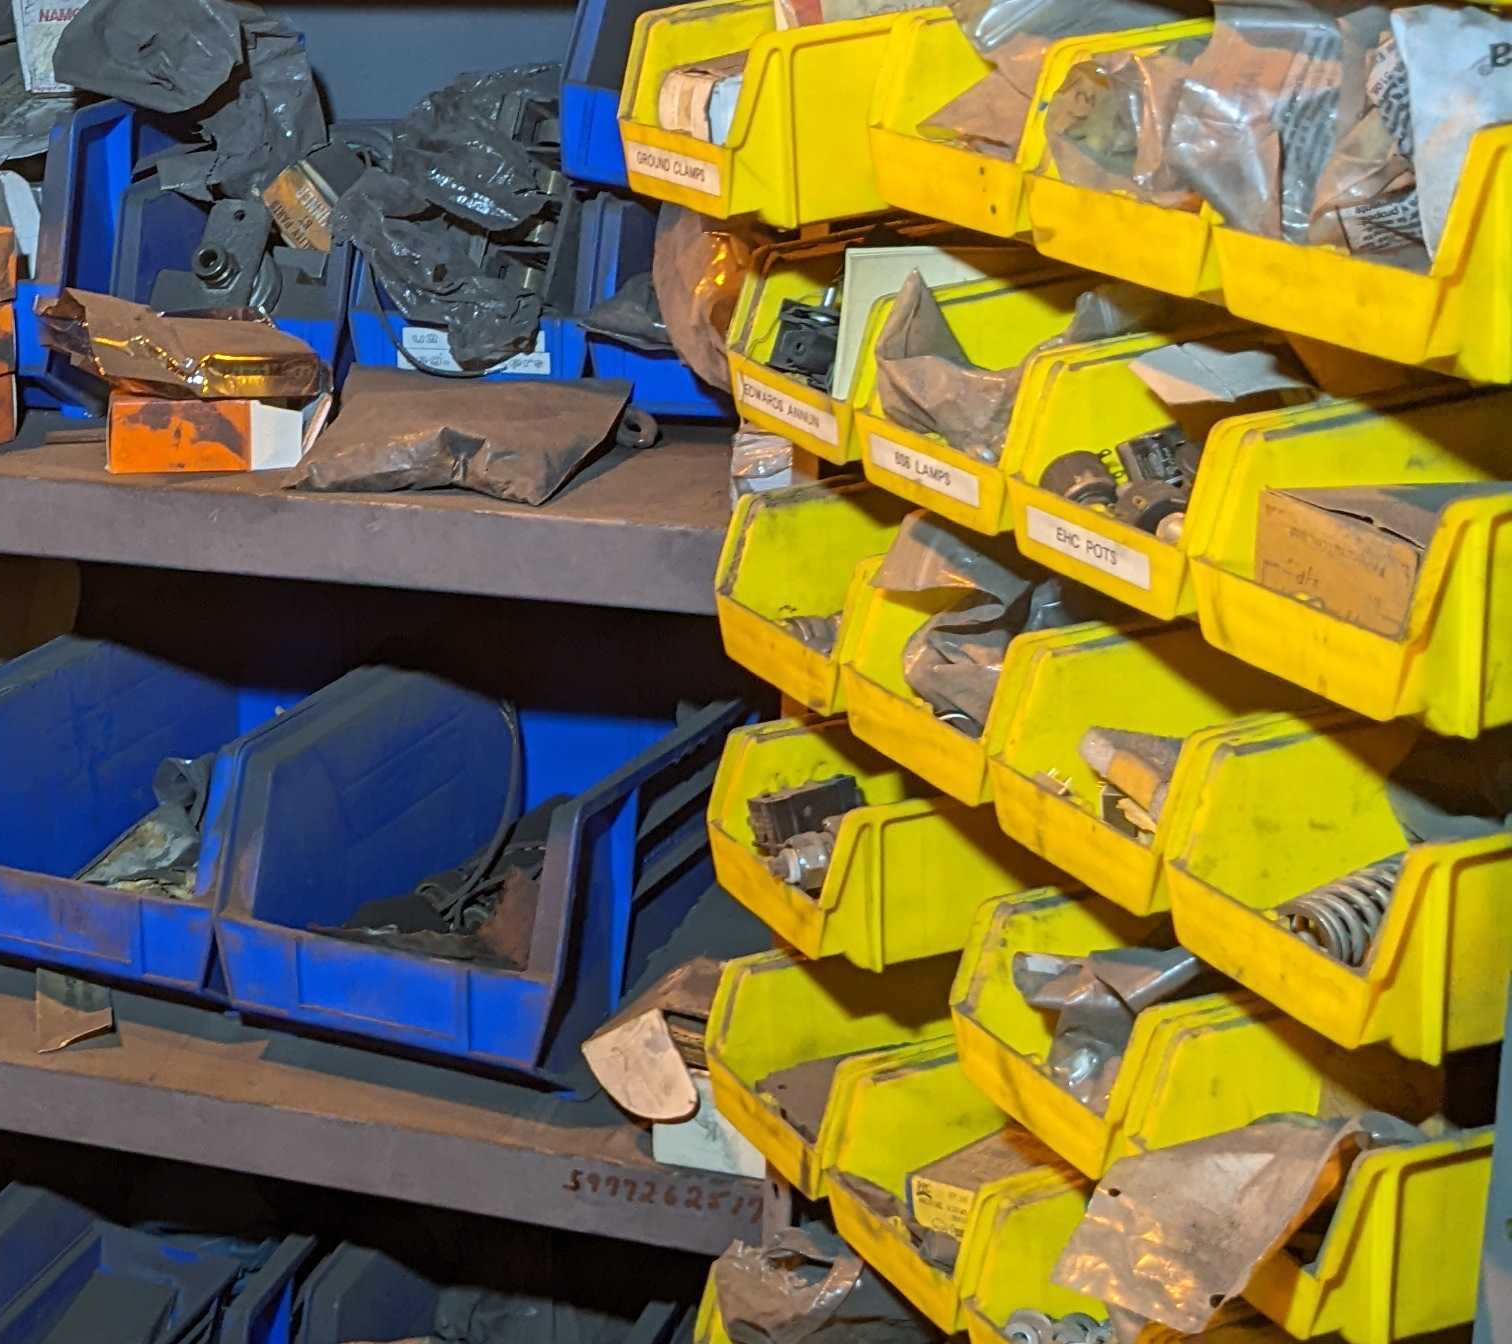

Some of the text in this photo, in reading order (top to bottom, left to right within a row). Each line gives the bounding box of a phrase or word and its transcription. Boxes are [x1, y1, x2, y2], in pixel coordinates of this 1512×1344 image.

[636, 150, 706, 183] GROUND CLAMPS
[1055, 526, 1118, 566] EHC POTS
